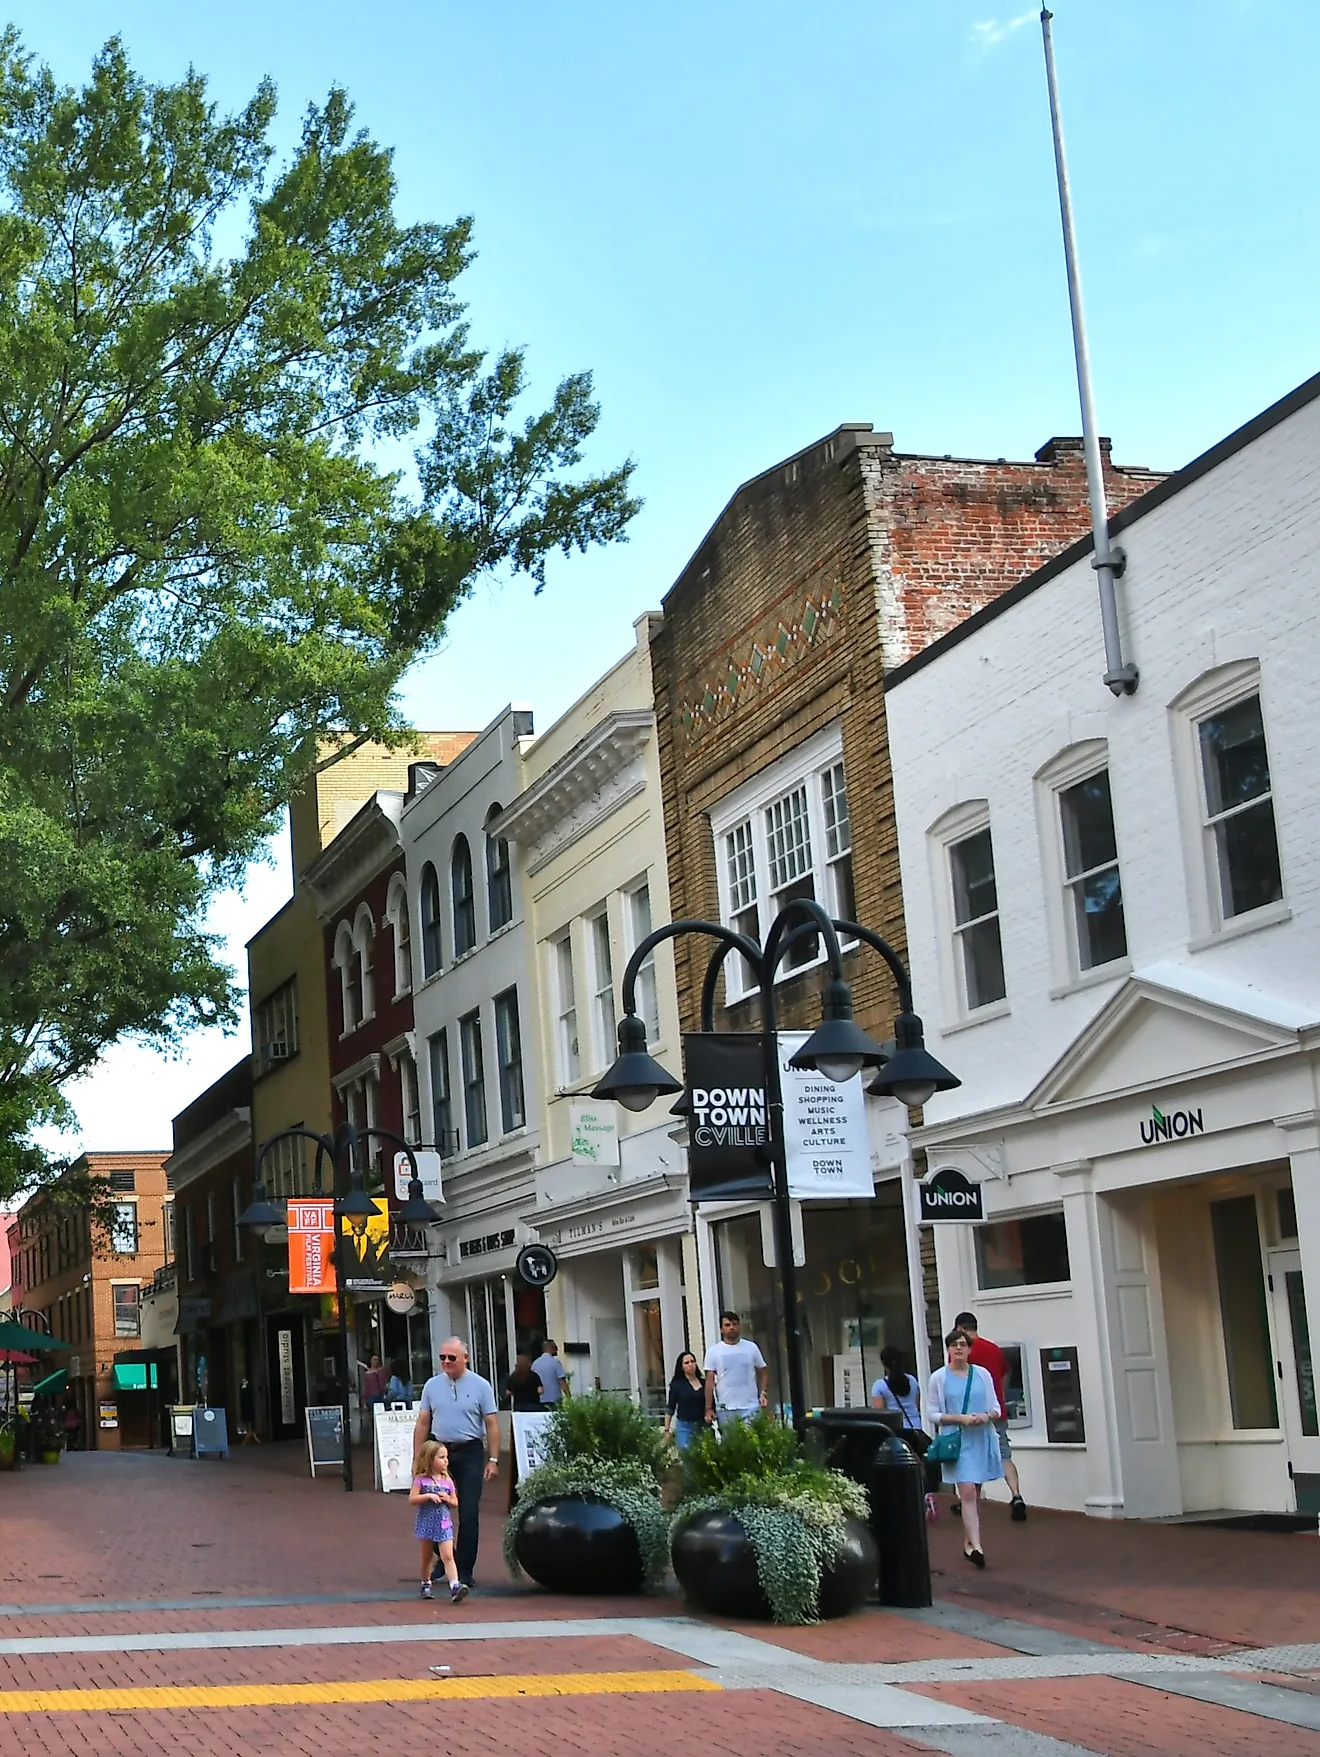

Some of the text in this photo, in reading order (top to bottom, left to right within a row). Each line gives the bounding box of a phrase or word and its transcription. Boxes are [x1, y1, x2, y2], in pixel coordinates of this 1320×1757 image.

[692, 1088, 765, 1107] DOWN
[798, 1096, 844, 1104] SHOPPING
[693, 1107, 766, 1126] TOWN
[807, 1106, 836, 1114] MUSIC
[798, 1116, 848, 1125] WELLNESS
[1139, 1105, 1205, 1144] UNION
[584, 1124, 616, 1133] Massage
[810, 1127, 836, 1135] ARTS
[694, 1126, 766, 1147] CVILLE
[803, 1138, 846, 1146] CULTURE
[924, 1188, 978, 1206] UNION
[312, 1233, 322, 1287] VIRGINIA
